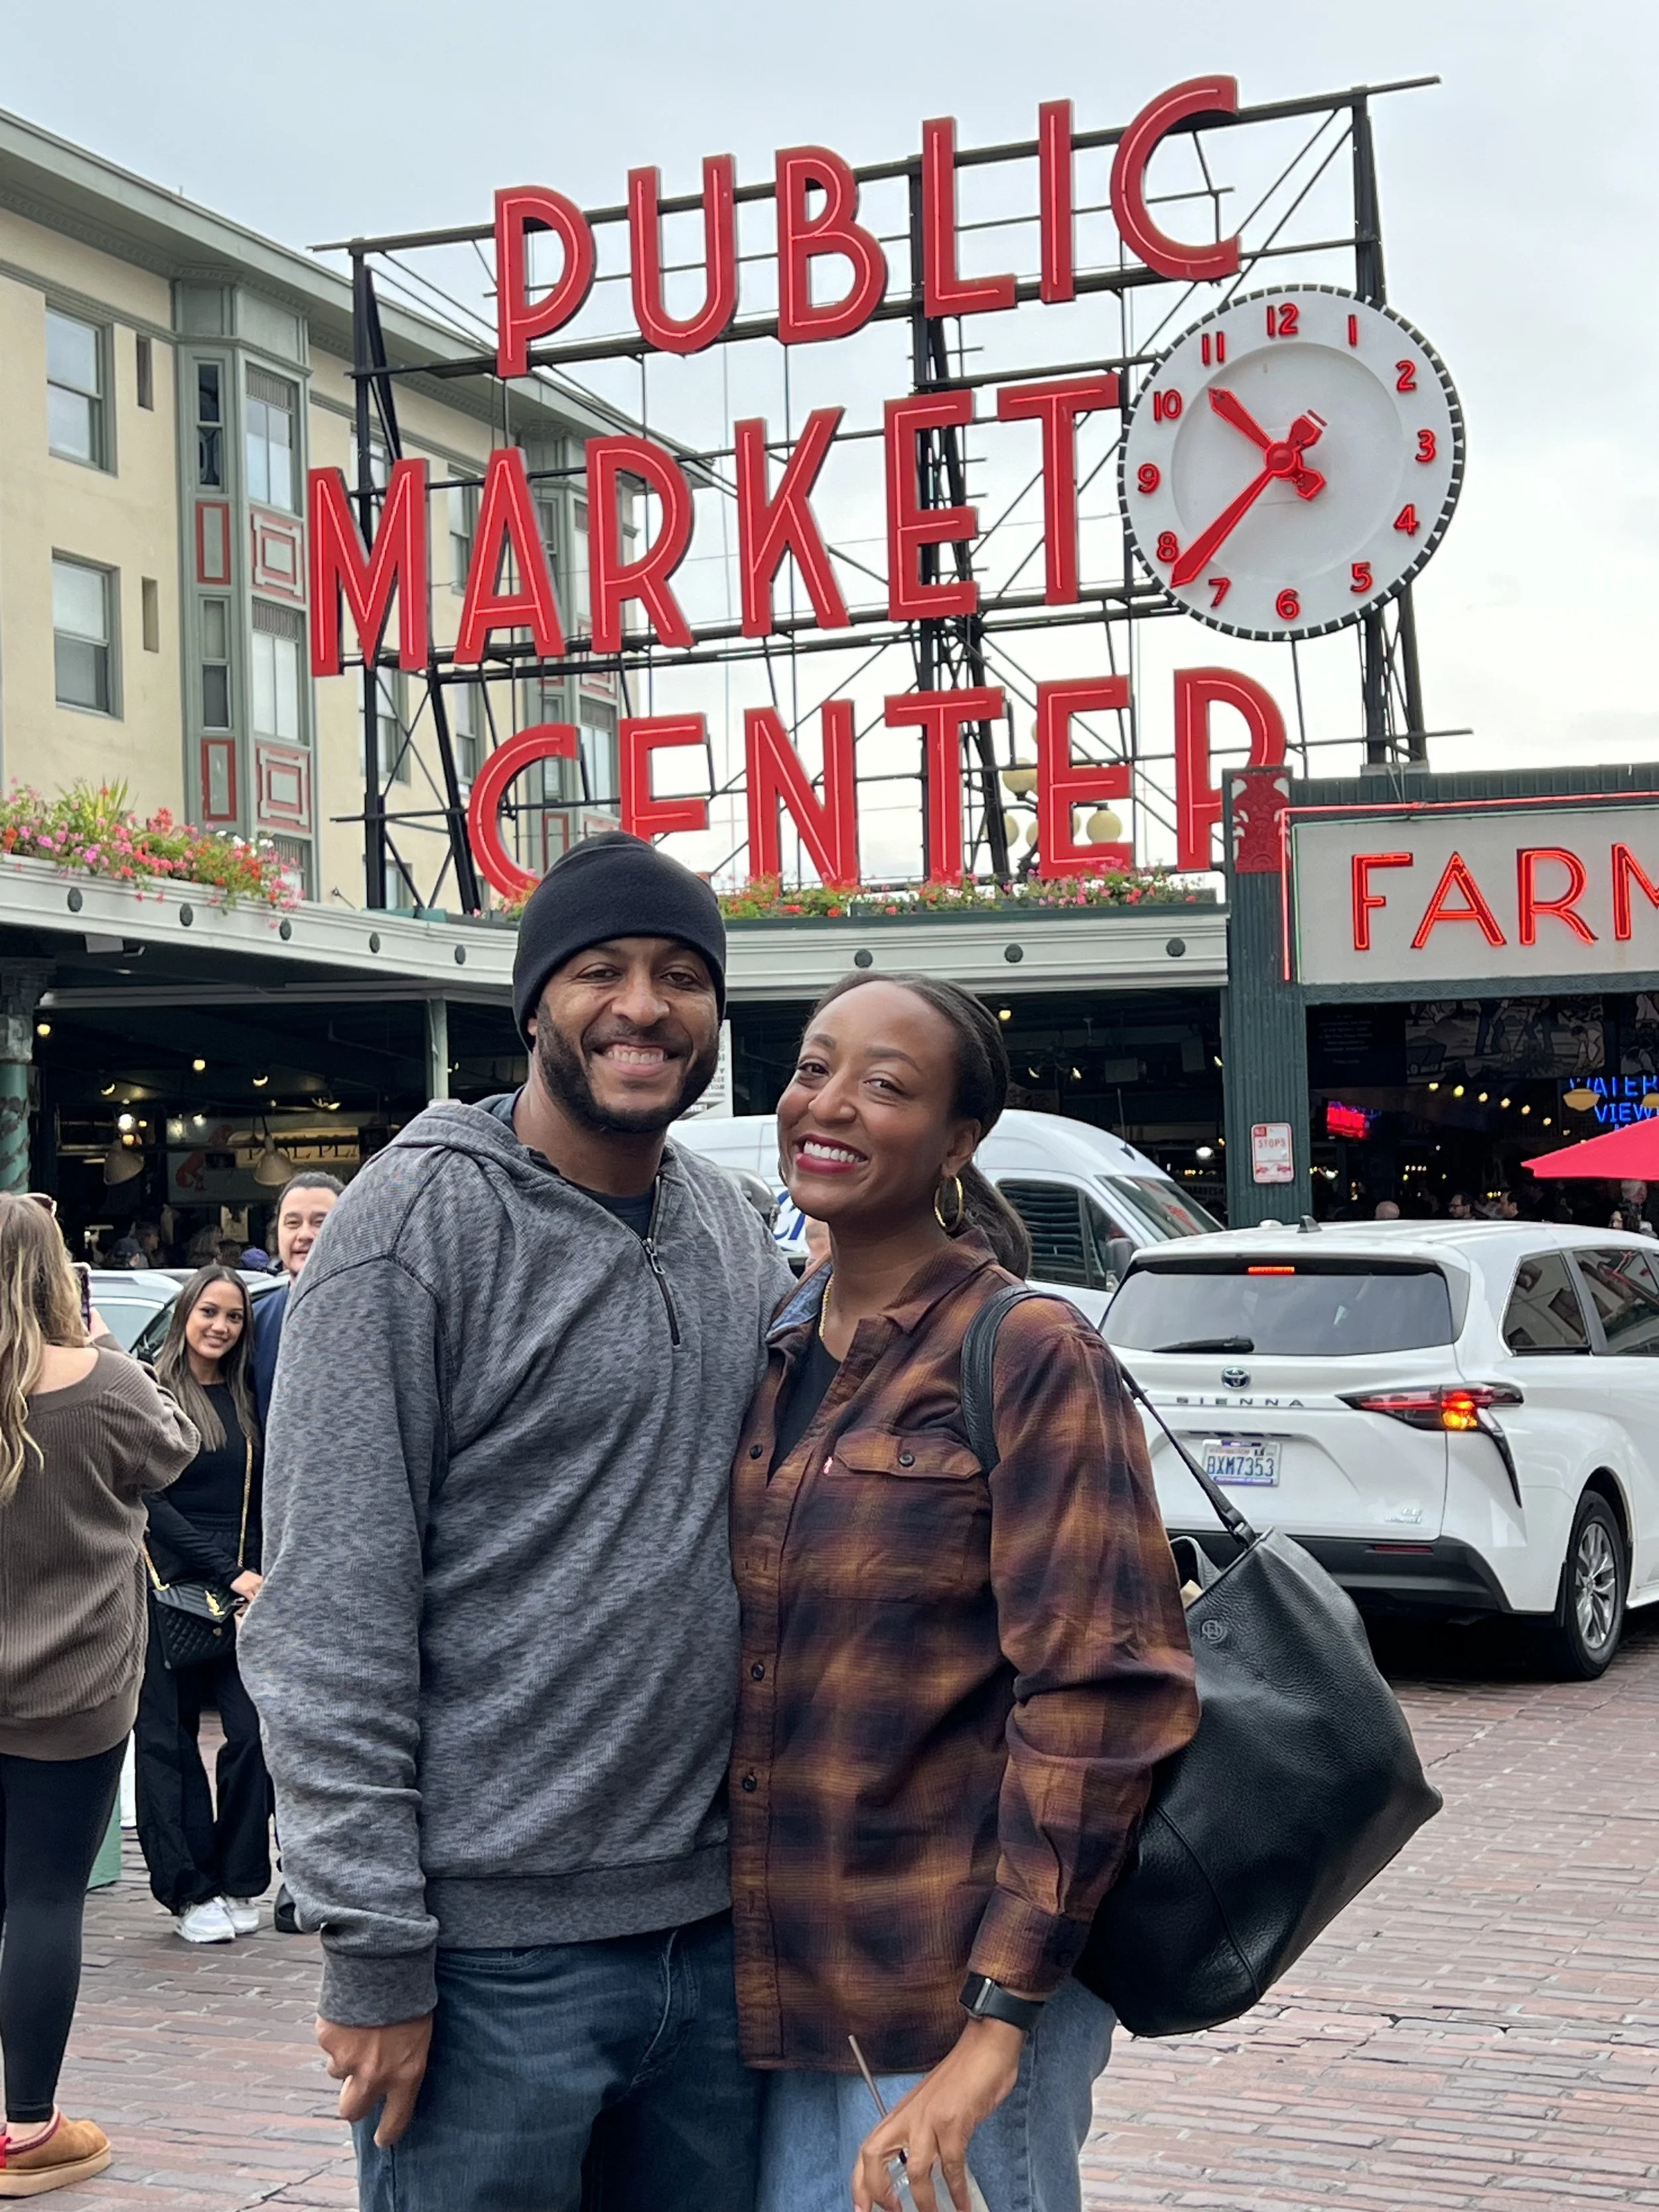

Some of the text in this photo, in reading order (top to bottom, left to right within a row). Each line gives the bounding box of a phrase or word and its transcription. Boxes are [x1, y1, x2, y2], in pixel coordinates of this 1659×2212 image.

[494, 77, 1240, 378] PUBLIC
[1266, 302, 1300, 337] 12
[1348, 315, 1359, 346] 1
[1201, 331, 1226, 366] 11
[1396, 360, 1417, 393] 2
[1153, 389, 1183, 423] 10
[1415, 429, 1437, 463] 3
[1137, 463, 1161, 495] 9
[308, 372, 1121, 678] MARKET
[1394, 503, 1419, 536] 4
[1157, 531, 1179, 563] 8
[1208, 576, 1232, 608] 7
[1350, 561, 1373, 594] 5
[1275, 588, 1301, 621] 6
[467, 668, 1286, 905] CENTER
[1176, 1397, 1305, 1408] SIENNA
